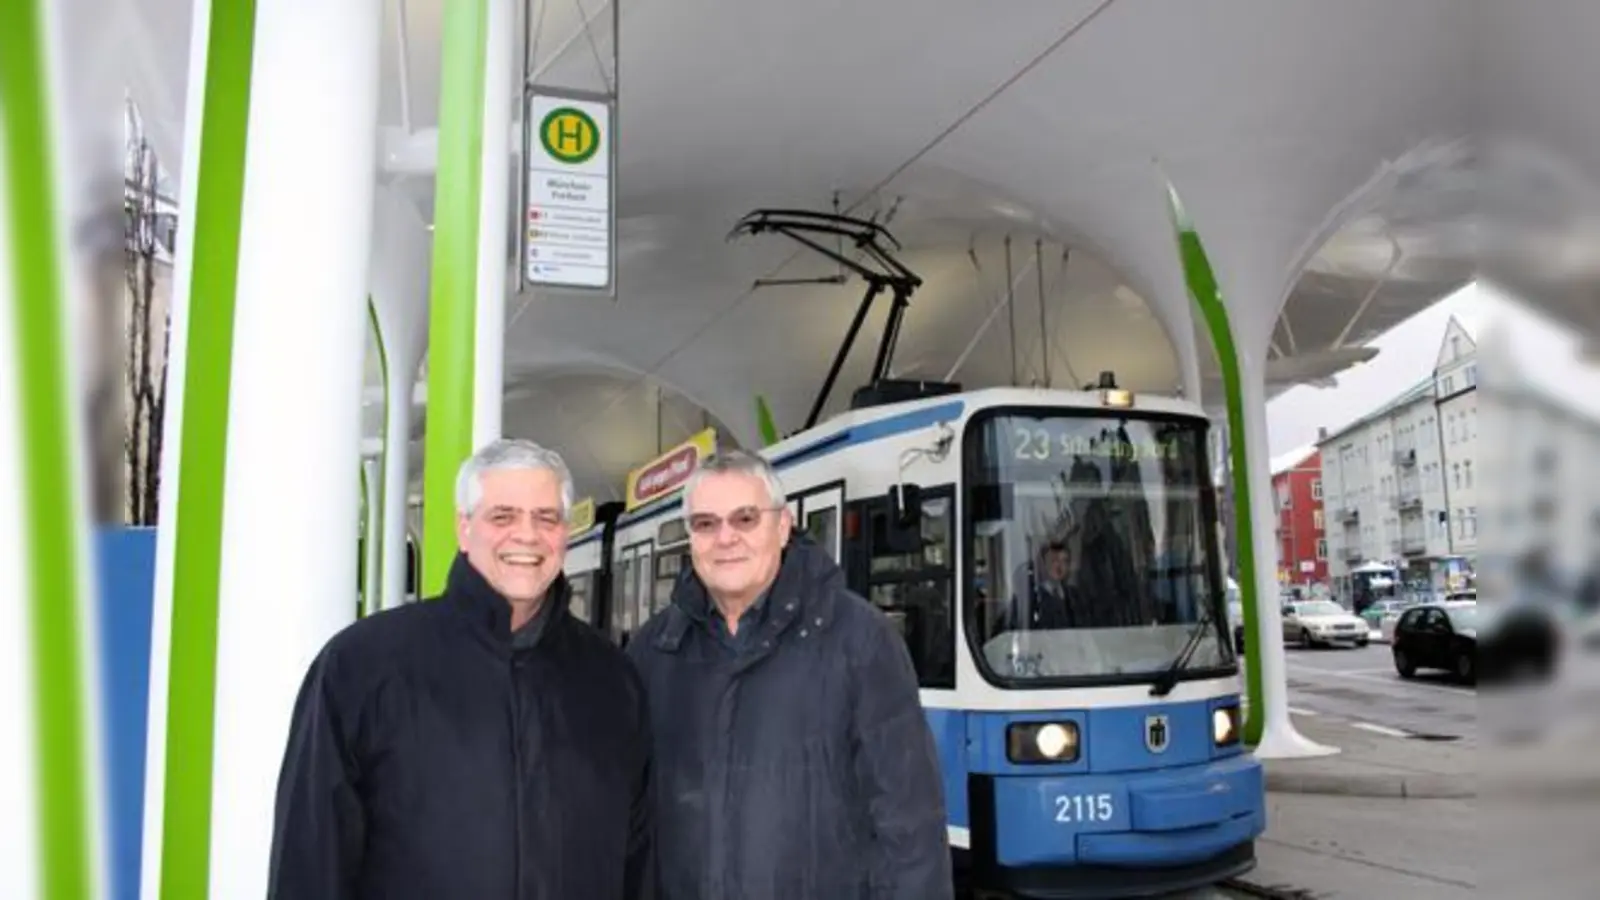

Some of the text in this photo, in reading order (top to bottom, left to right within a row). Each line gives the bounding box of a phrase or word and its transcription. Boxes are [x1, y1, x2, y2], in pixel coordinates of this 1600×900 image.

[558, 119, 582, 152] H
[1015, 427, 1051, 460] 23
[1055, 793, 1113, 822] 2115
